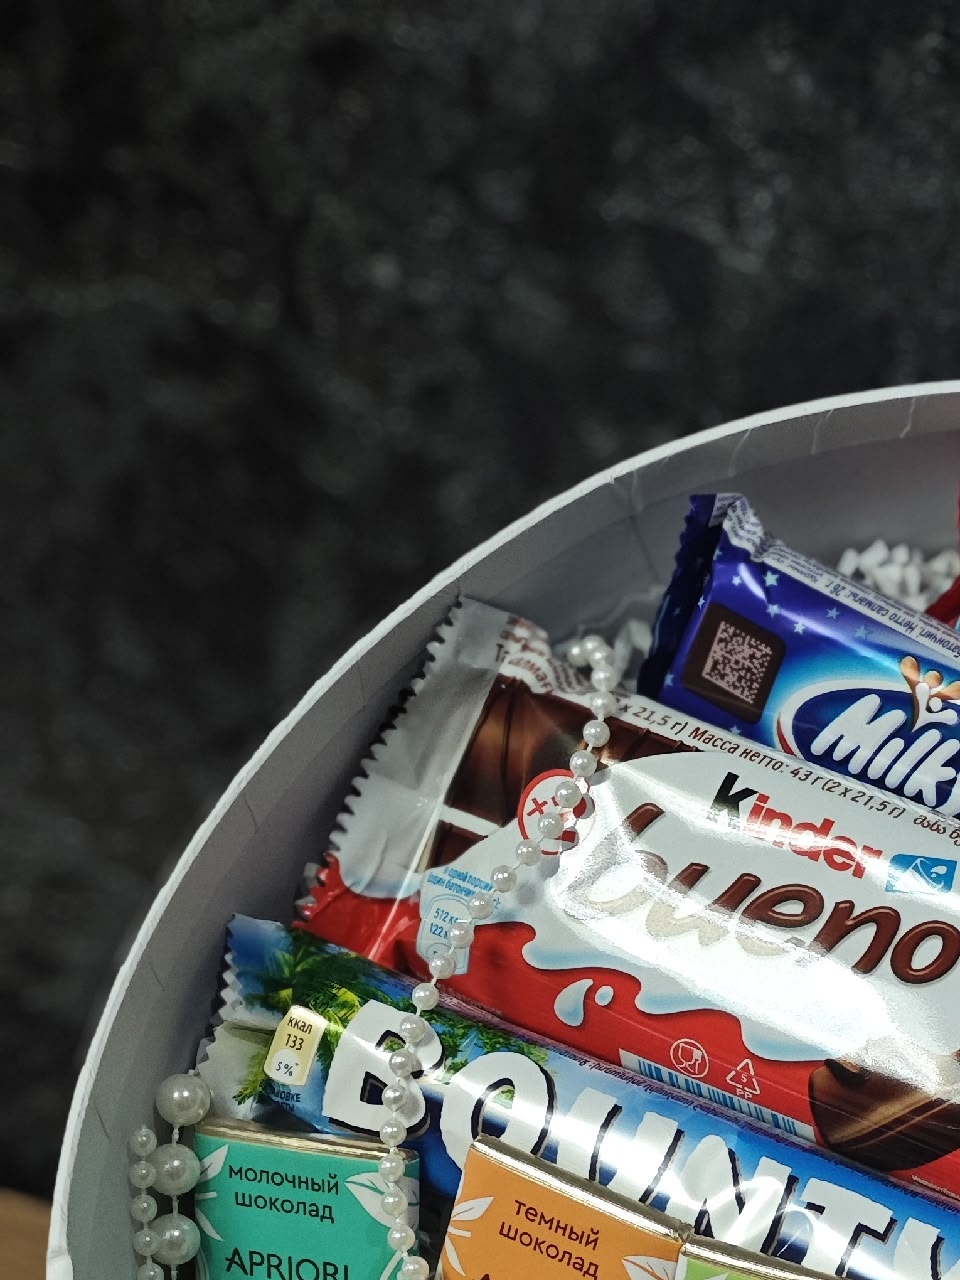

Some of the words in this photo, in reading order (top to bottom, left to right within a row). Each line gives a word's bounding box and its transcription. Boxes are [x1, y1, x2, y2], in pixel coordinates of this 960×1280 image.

[632, 706, 669, 730] 21,5
[687, 727, 740, 754] Масса
[738, 747, 785, 773] нетто:
[789, 766, 810, 783] 43
[851, 791, 888, 813] 21,5
[708, 771, 883, 879] Kinder
[430, 923, 444, 938] 122
[434, 908, 449, 922] 512
[285, 1033, 305, 1051] 133
[287, 1016, 313, 1035] ккал
[227, 1163, 341, 1197] молочный
[234, 1192, 335, 1225] шоколад
[513, 1198, 600, 1252] темный
